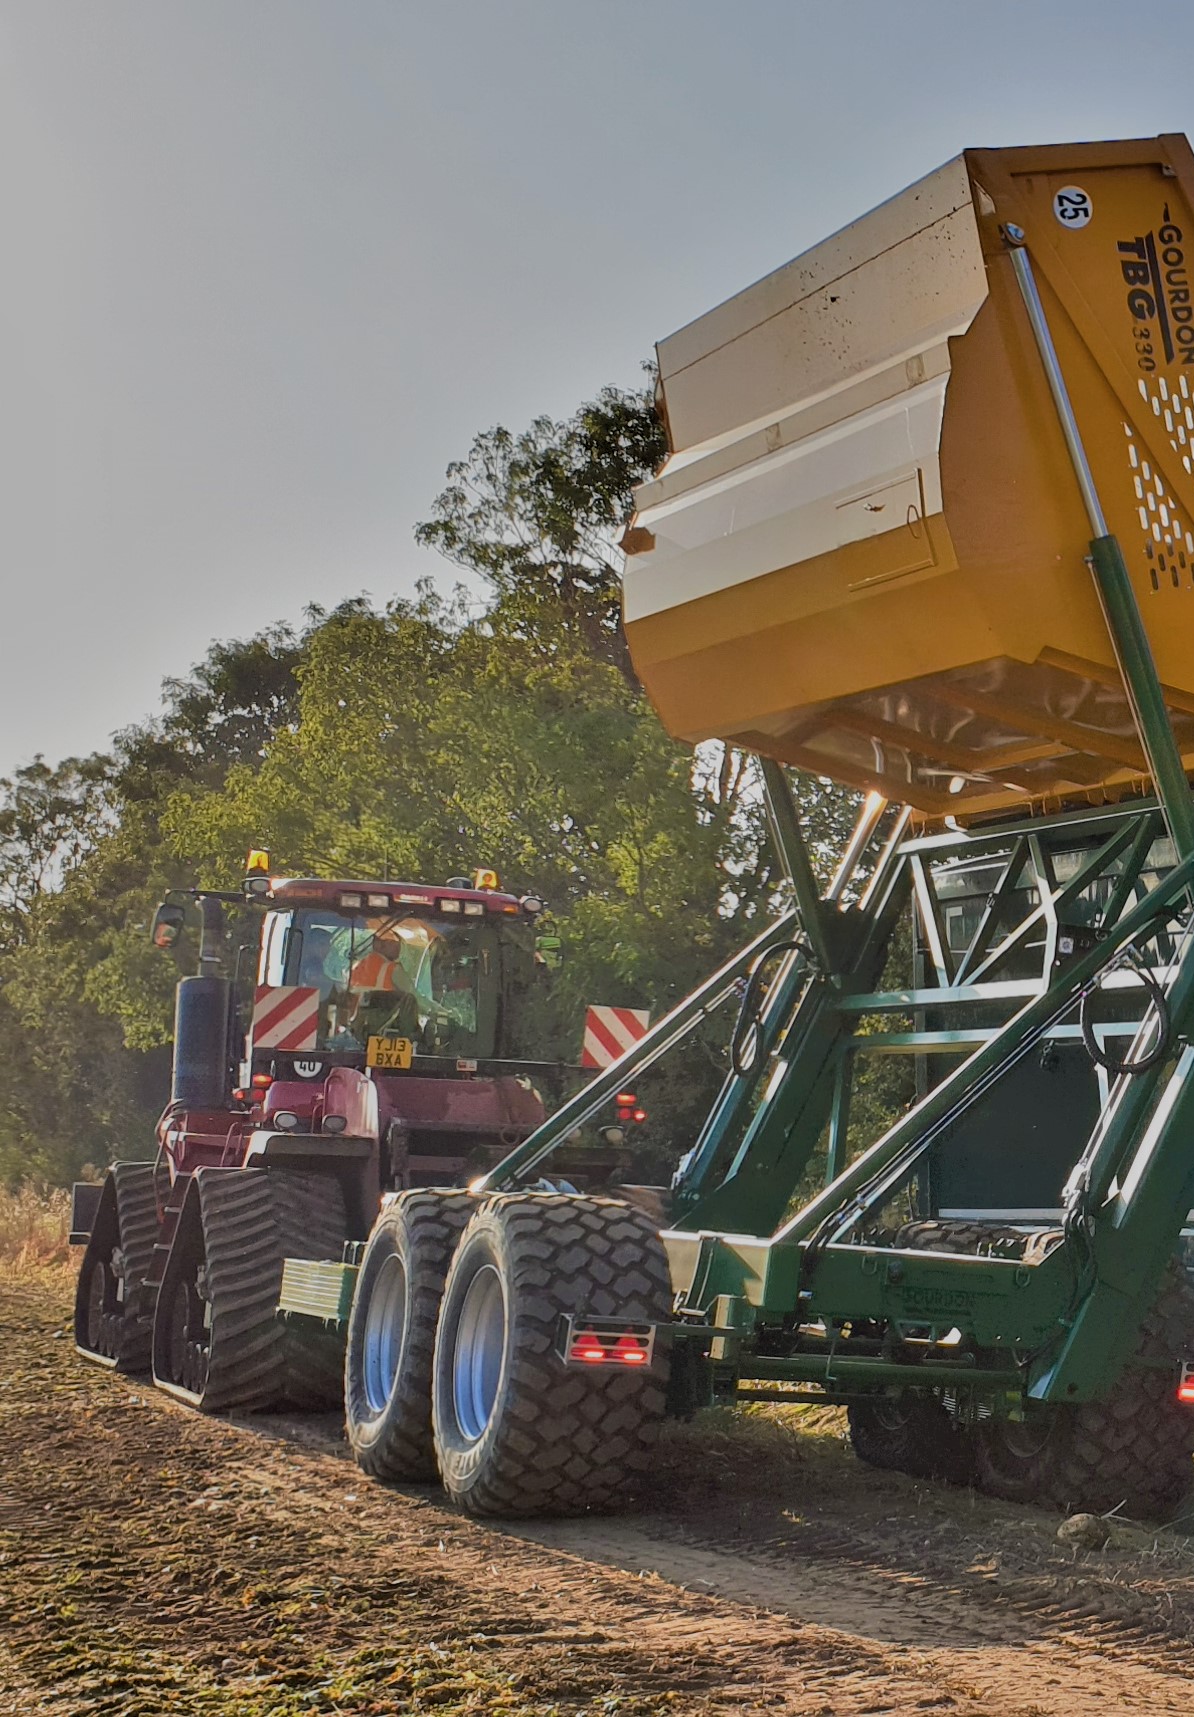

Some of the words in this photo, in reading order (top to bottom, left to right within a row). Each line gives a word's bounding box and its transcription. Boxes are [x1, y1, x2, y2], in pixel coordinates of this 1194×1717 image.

[1057, 193, 1089, 220] 25
[1117, 236, 1156, 320] TBG
[376, 1037, 406, 1052] YJ13
[376, 1053, 402, 1067] BXA
